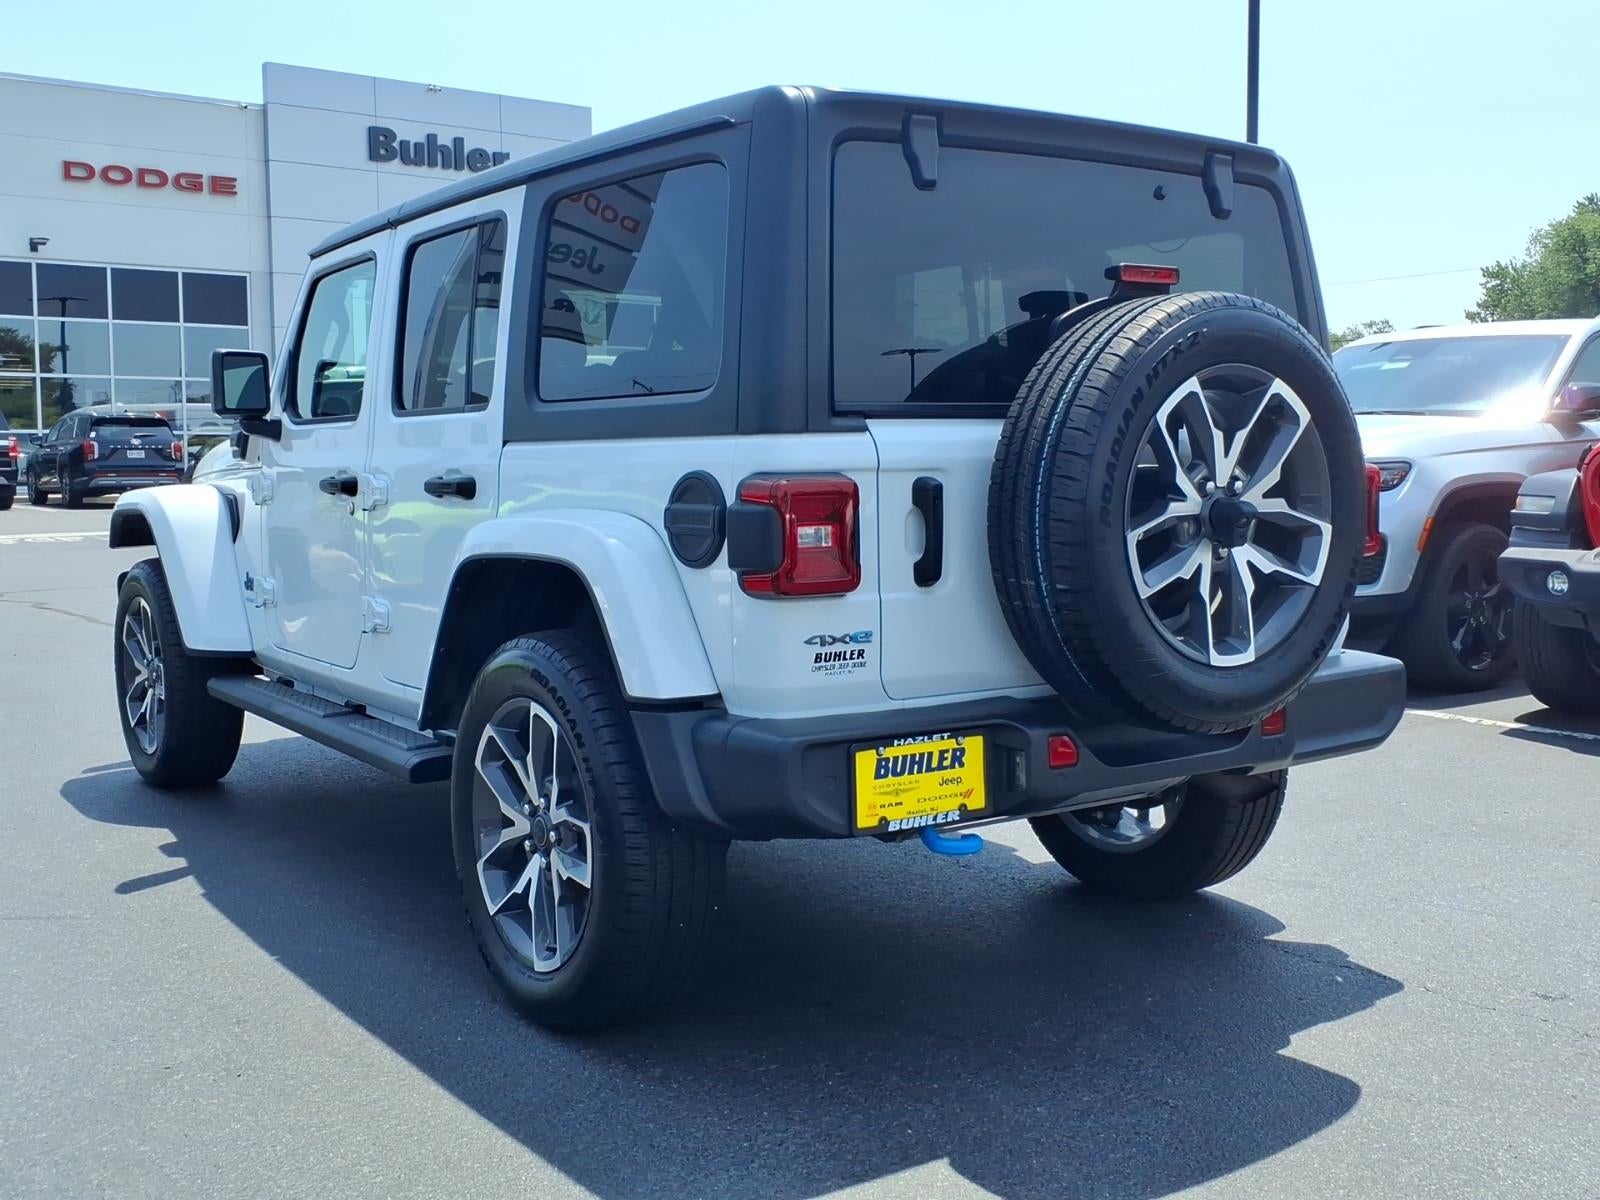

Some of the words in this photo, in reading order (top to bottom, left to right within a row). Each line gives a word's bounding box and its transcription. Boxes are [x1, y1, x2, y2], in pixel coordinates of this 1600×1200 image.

[368, 125, 511, 174] Buhler
[62, 159, 238, 196] DODGE
[813, 648, 865, 664] BUHLER
[893, 732, 952, 747] HAZLET
[873, 747, 967, 781] BUHLER
[872, 780, 920, 791] CHRYSLER
[938, 776, 963, 787] Jeep
[879, 801, 904, 809] RAM
[888, 810, 960, 831] BUHLER
